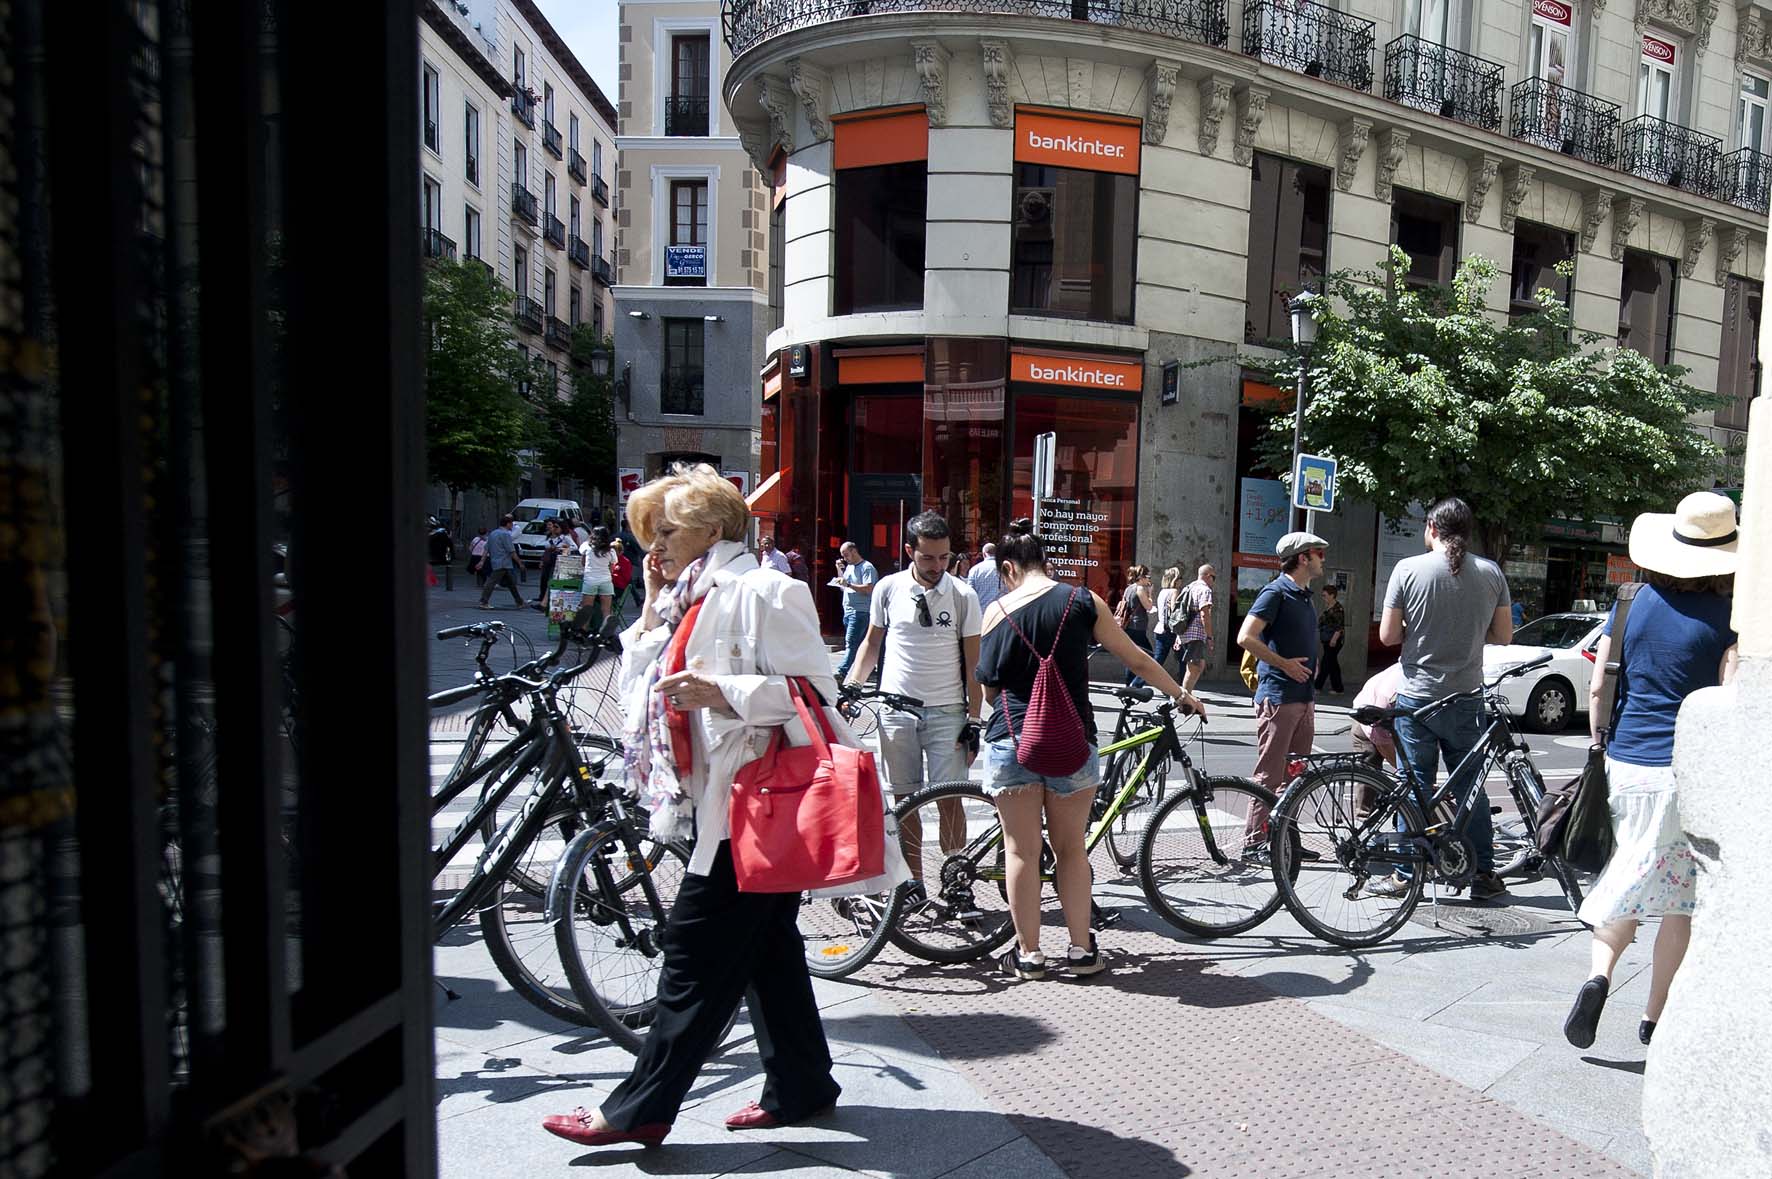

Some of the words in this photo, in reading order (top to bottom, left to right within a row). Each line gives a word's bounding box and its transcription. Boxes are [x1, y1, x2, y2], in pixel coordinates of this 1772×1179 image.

[1534, 1, 1564, 18] SVENSON
[1642, 40, 1669, 57] SVENSON
[1040, 509, 1053, 518] No
[1055, 509, 1074, 521] hay
[1076, 511, 1109, 523] mayor
[1040, 521, 1099, 533] compromiso
[1057, 544, 1068, 553] el
[1465, 745, 1499, 811] IDEAL
[483, 776, 554, 875] IDEAL
